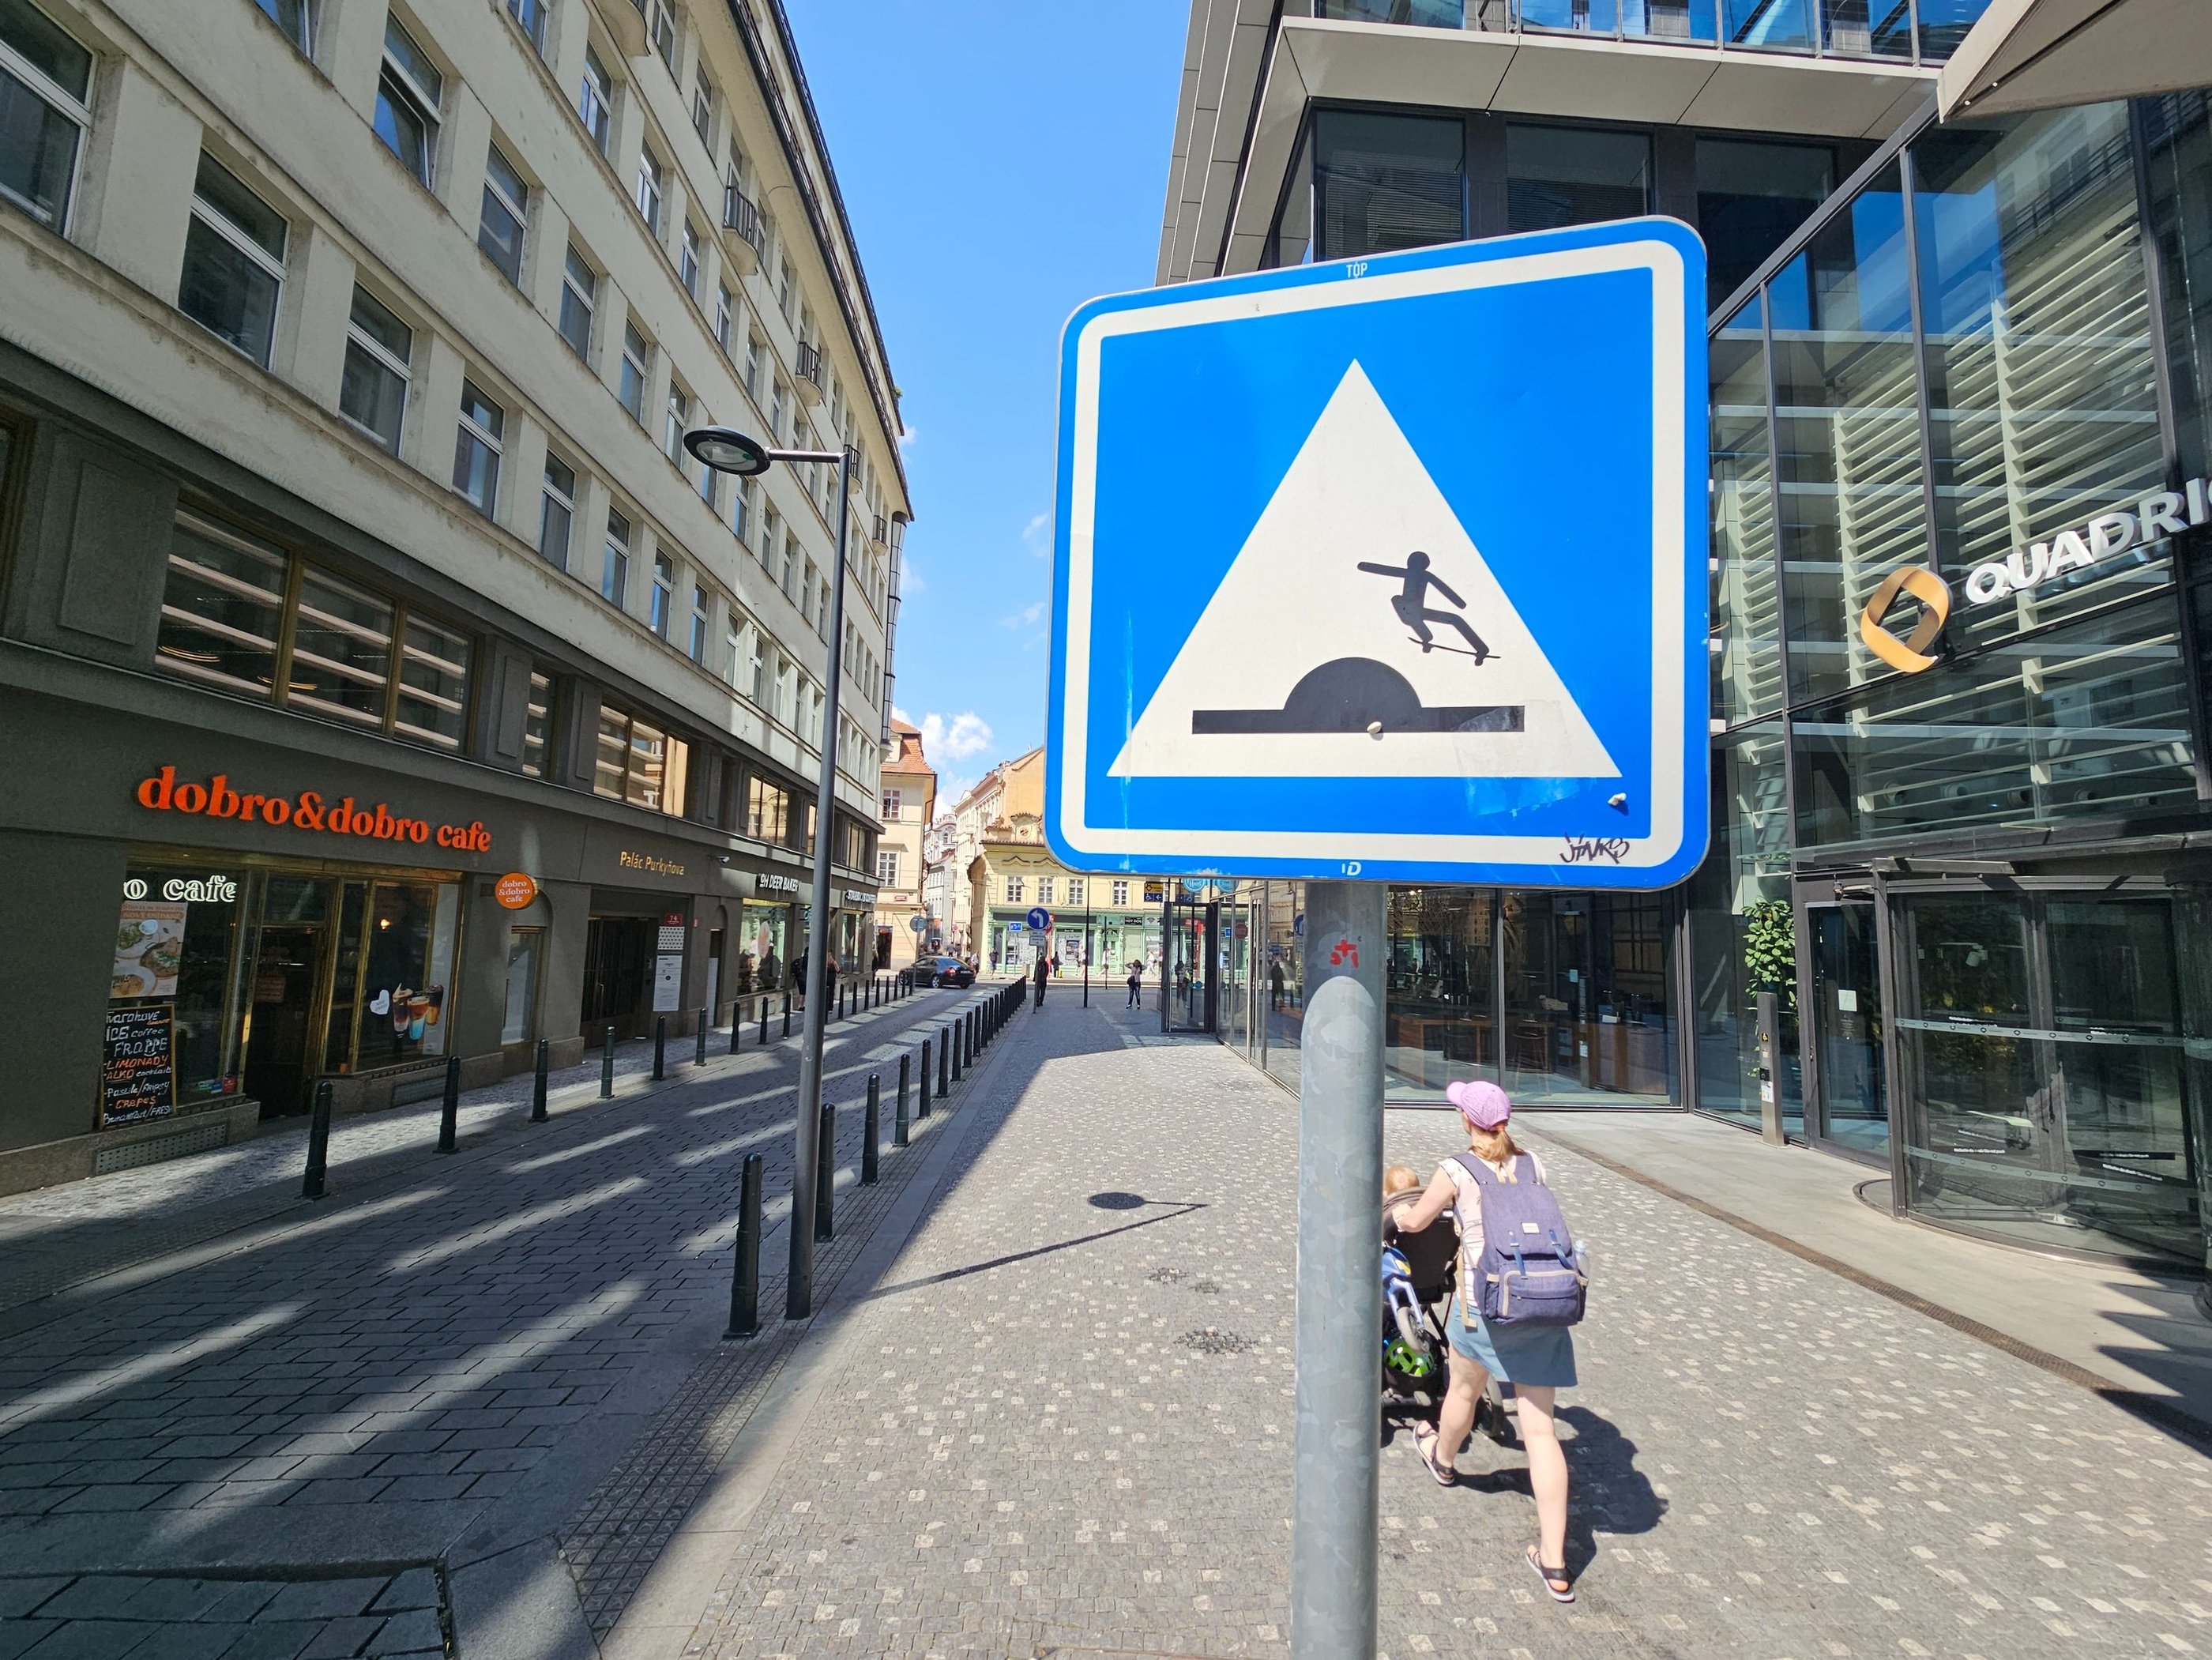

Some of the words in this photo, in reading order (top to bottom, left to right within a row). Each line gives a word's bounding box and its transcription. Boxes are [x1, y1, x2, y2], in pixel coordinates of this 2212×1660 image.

[1346, 262, 1367, 278] TOP
[1966, 477, 2212, 604] QUADRI
[137, 766, 429, 842] dobro&dobro
[436, 821, 491, 853] cafe
[619, 851, 643, 869] Palác
[163, 875, 237, 902] cafe
[131, 1028, 164, 1037] coffee
